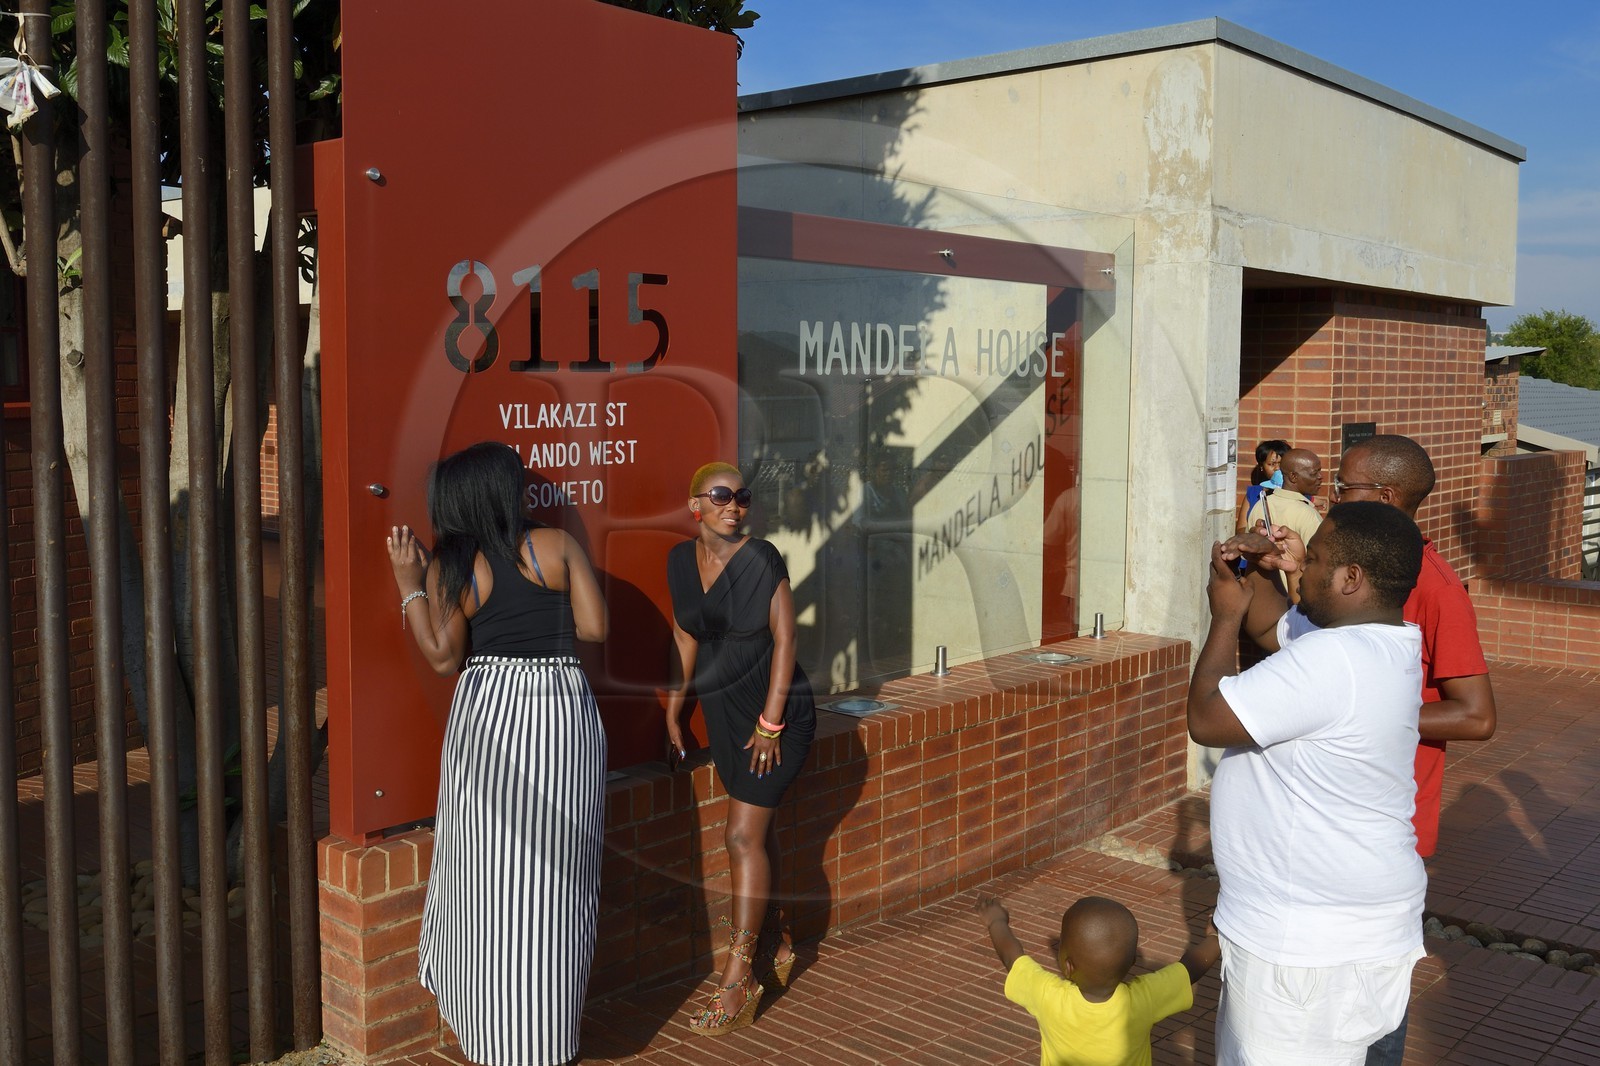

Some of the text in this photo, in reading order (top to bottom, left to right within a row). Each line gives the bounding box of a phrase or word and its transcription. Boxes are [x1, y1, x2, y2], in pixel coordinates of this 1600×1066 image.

[444, 259, 670, 374] 8115
[799, 320, 1066, 378] MANDELA HOUSE
[499, 402, 628, 430] VILAKAZI ST
[589, 439, 638, 466] WEST
[527, 479, 604, 509] SOWETO
